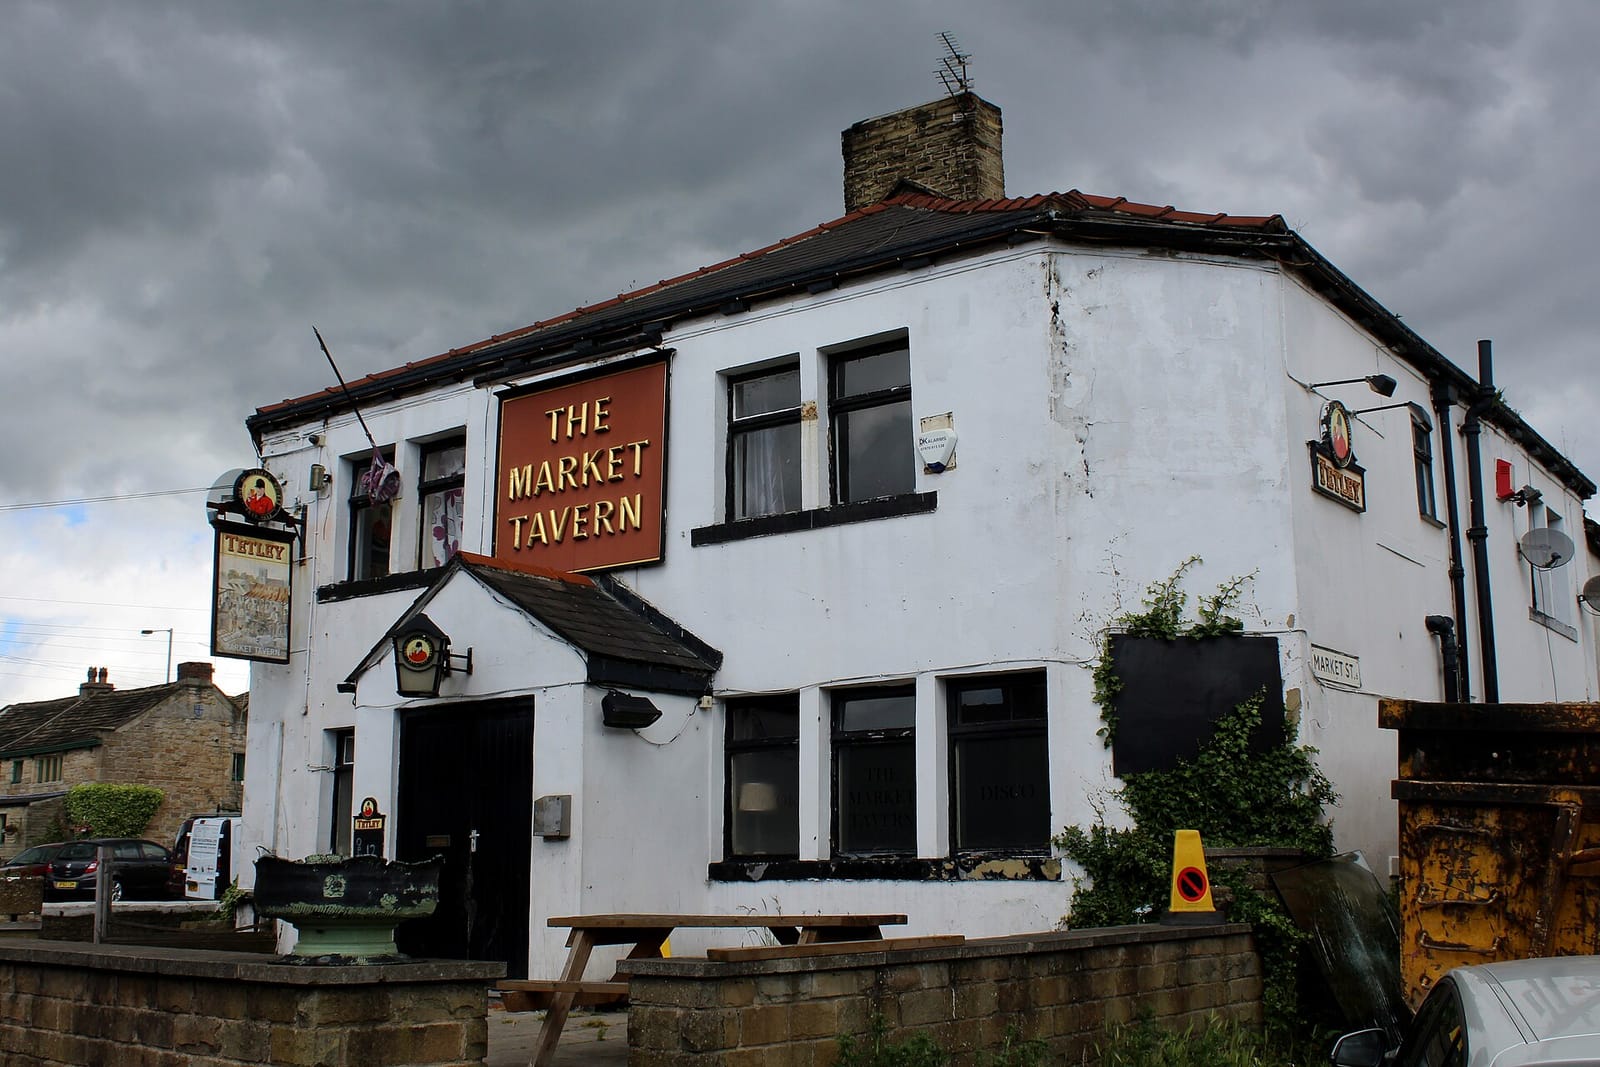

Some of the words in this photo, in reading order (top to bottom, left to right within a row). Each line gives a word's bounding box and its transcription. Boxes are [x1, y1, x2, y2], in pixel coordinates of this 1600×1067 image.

[545, 396, 611, 442] THE
[508, 439, 650, 501] MARKET
[1319, 458, 1361, 504] TETLEY
[508, 493, 642, 551] TAVERN
[225, 535, 285, 560] TETLEY
[1313, 654, 1343, 676] MARKET
[980, 784, 1035, 801] DISCO
[357, 820, 380, 828] TETLEY
